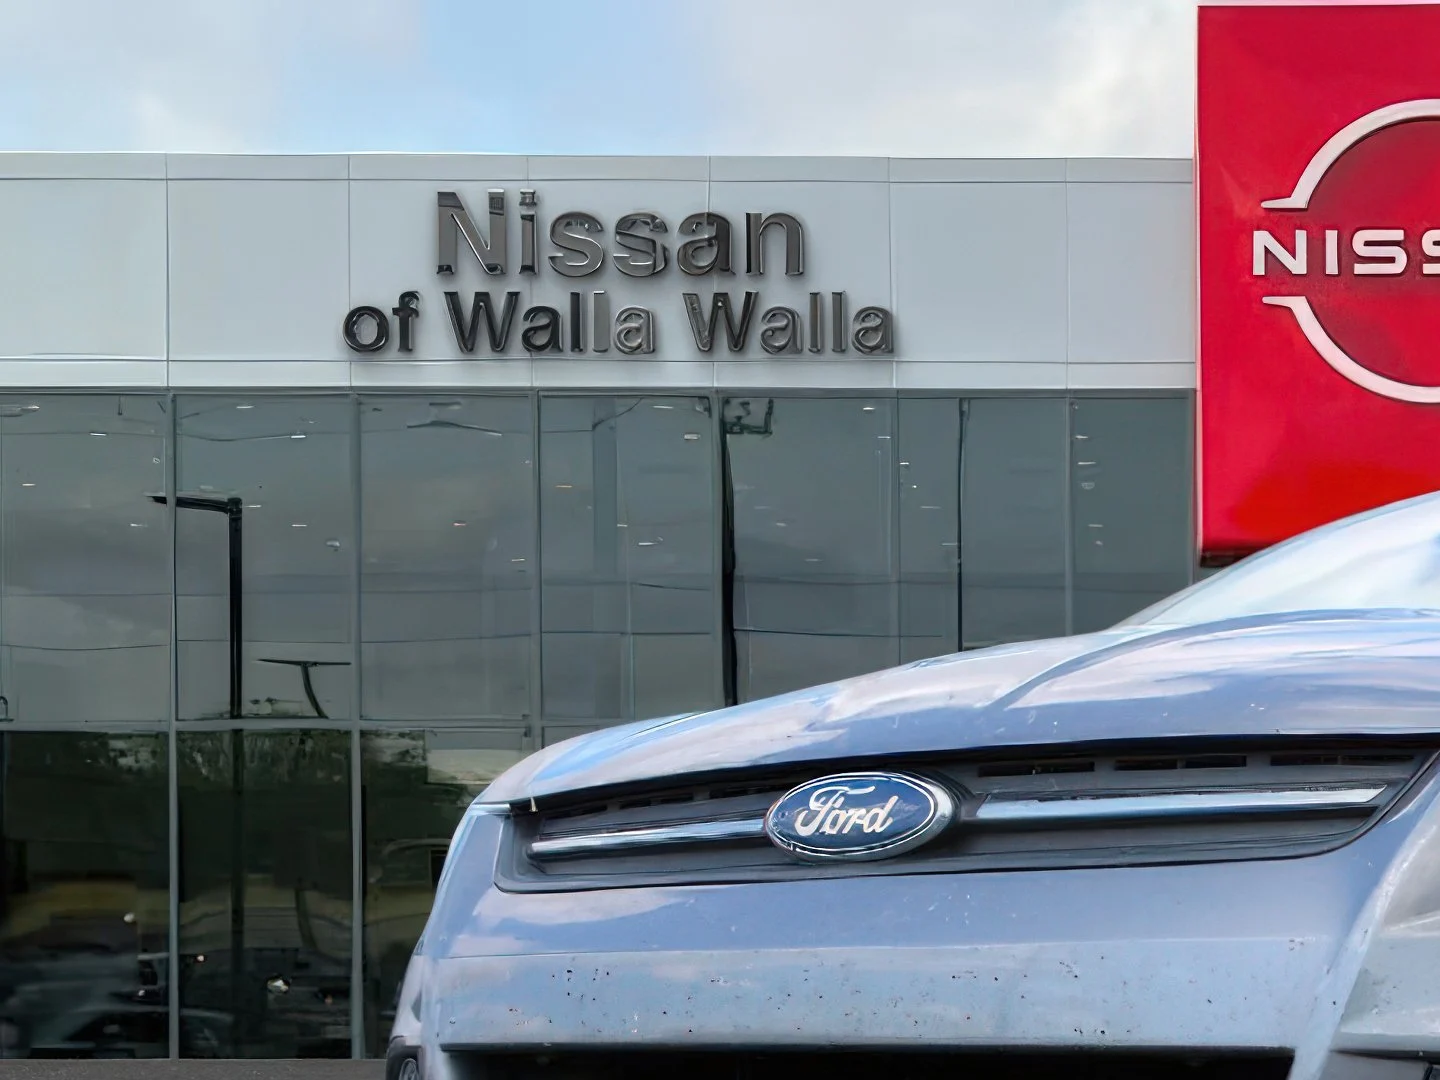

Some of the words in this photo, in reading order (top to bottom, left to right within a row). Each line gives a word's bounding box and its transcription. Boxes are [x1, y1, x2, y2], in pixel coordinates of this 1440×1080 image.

[435, 188, 805, 277] Nissan
[342, 290, 420, 353] of
[443, 290, 656, 353] Walla
[682, 290, 894, 354] Walla
[795, 786, 898, 836] Ford
